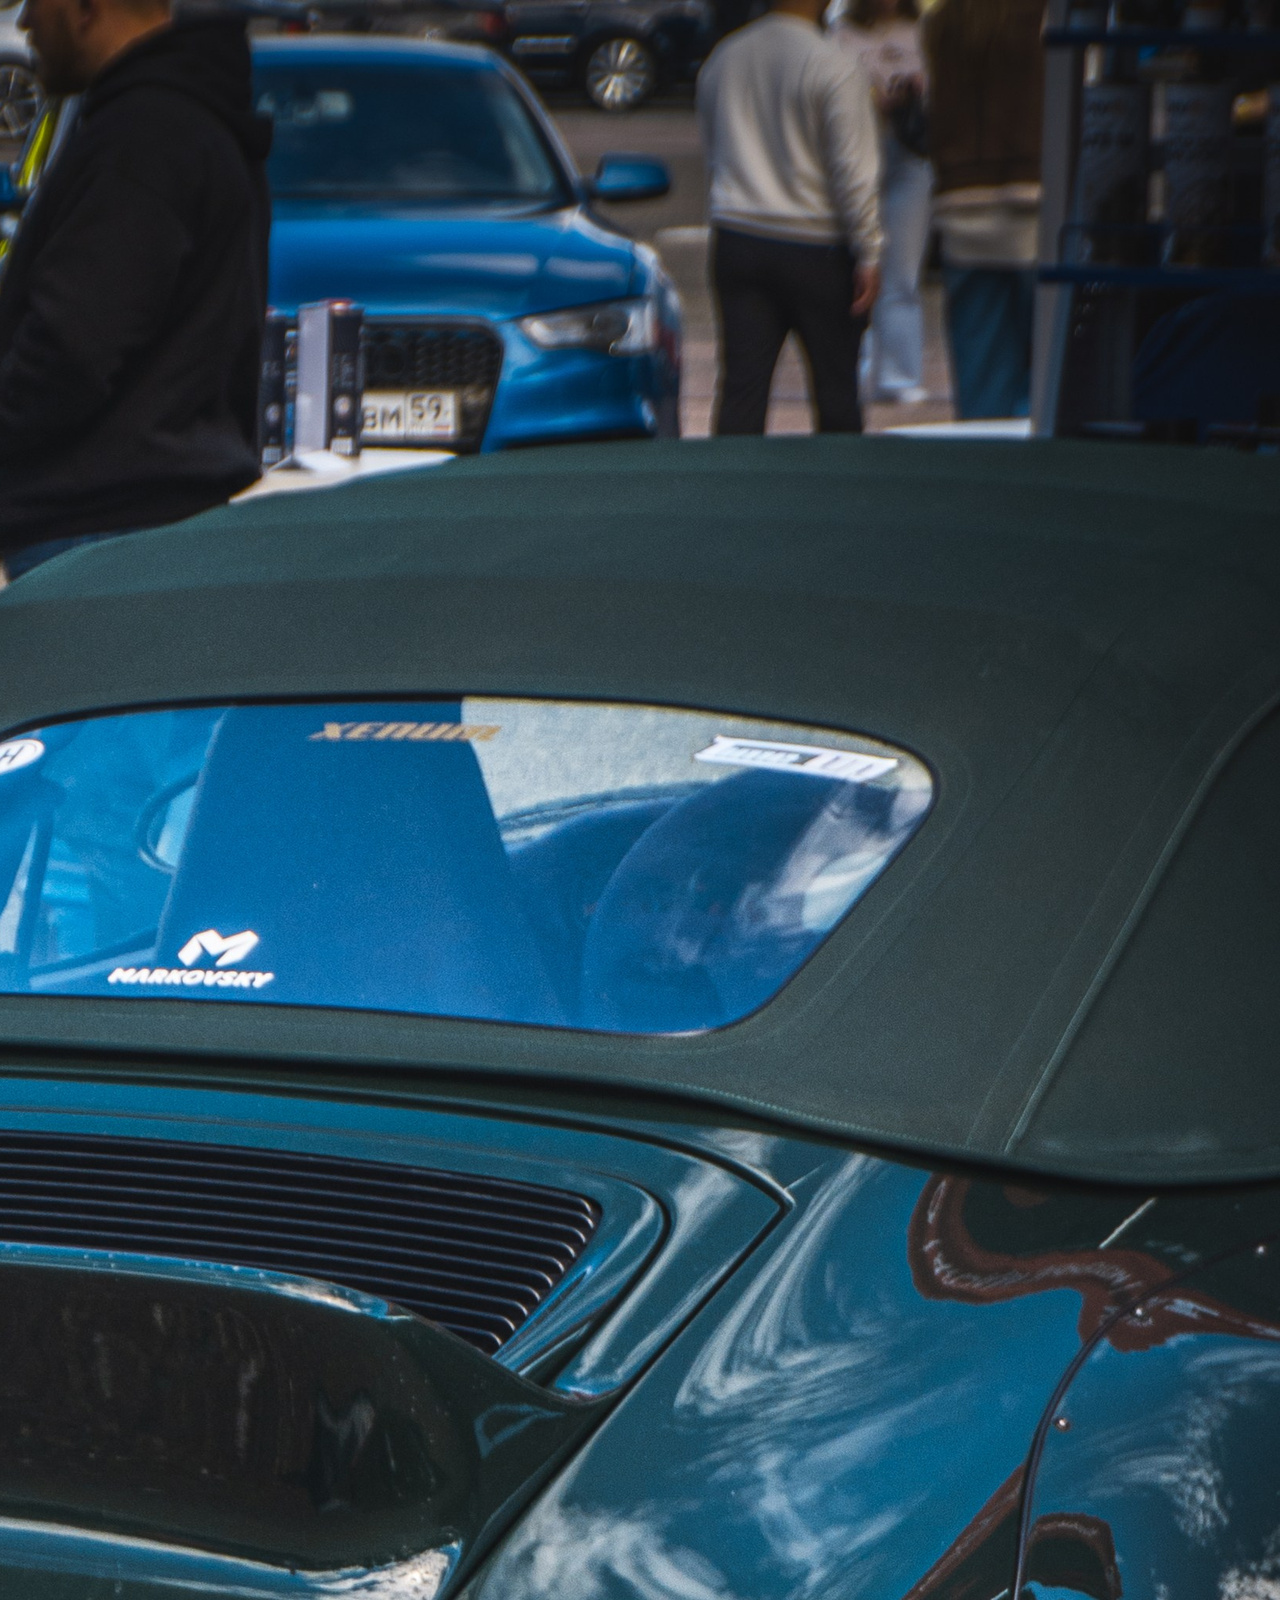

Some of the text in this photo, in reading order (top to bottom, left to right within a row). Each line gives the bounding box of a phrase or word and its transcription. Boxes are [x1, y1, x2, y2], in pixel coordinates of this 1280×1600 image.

[410, 392, 443, 421] 59
[308, 722, 502, 742] XENUM
[107, 967, 275, 989] MARKOVSKY
